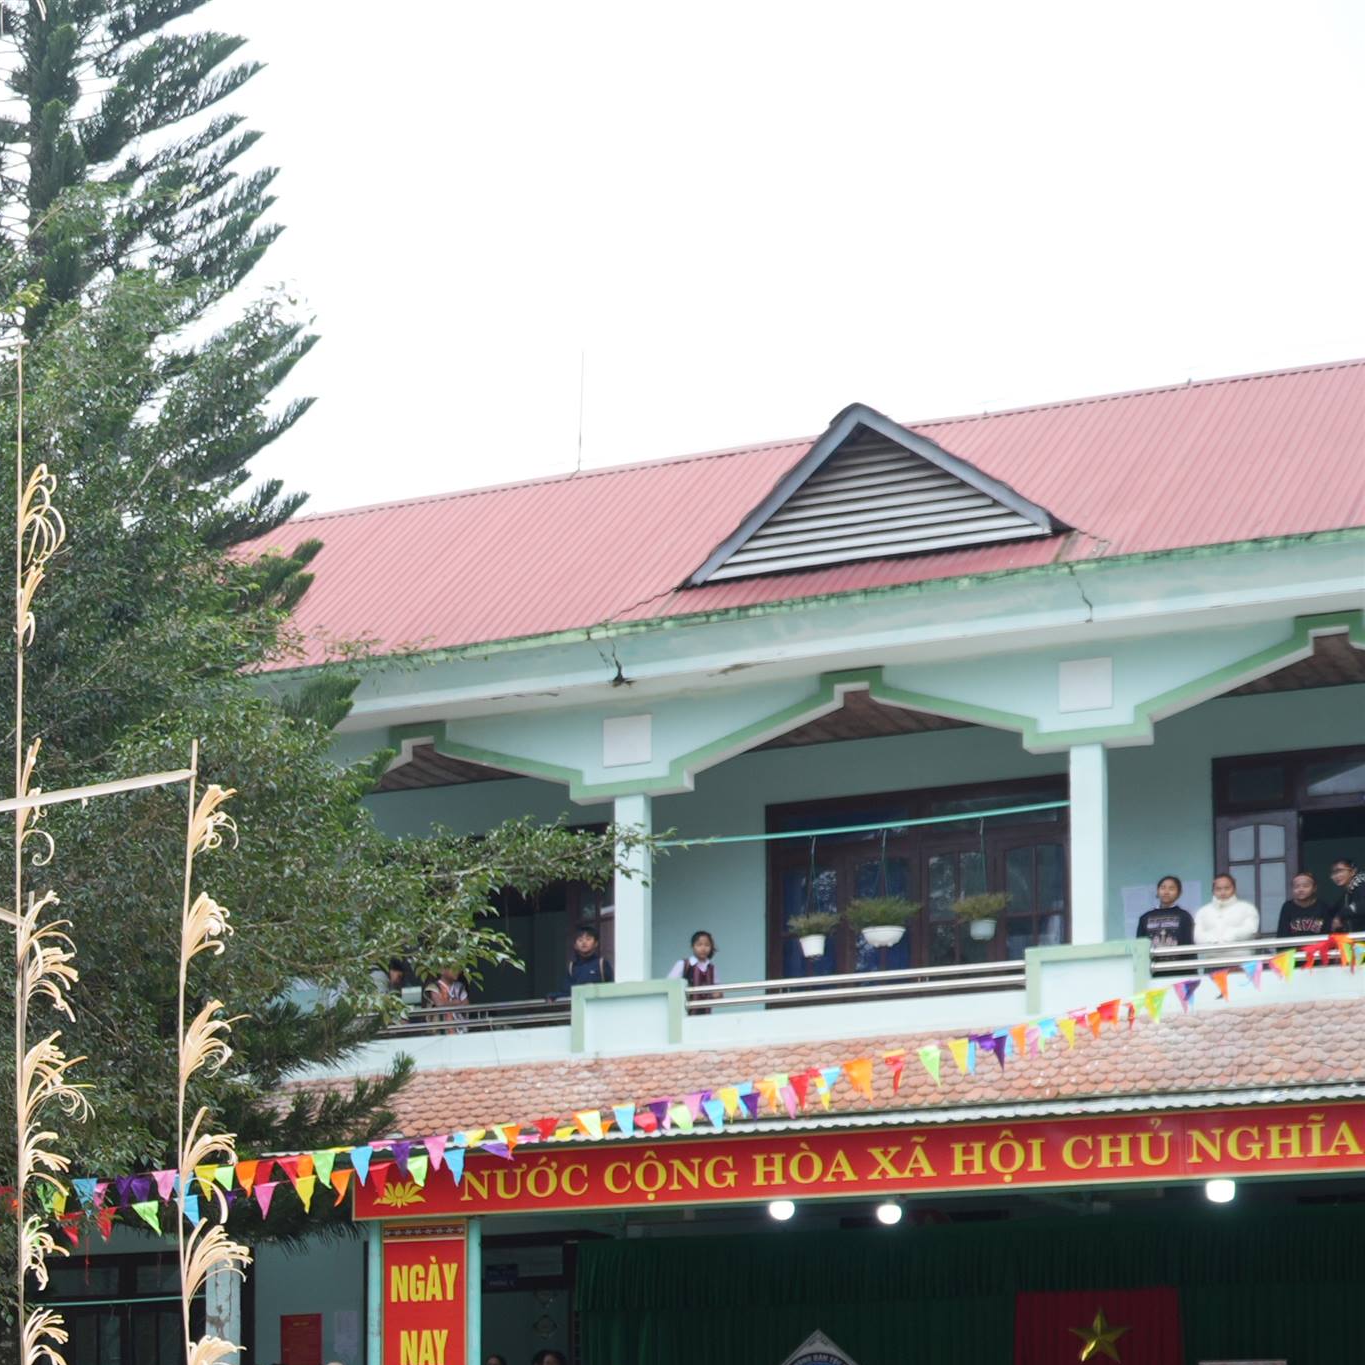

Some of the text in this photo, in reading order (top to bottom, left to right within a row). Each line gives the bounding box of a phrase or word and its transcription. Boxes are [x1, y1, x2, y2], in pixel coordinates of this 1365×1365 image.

[461, 1113, 1364, 1201] NƯỚC CỘNG HÒA XÃ HỘI CHỦ NGHĨA
[390, 1256, 457, 1302] NGÀY
